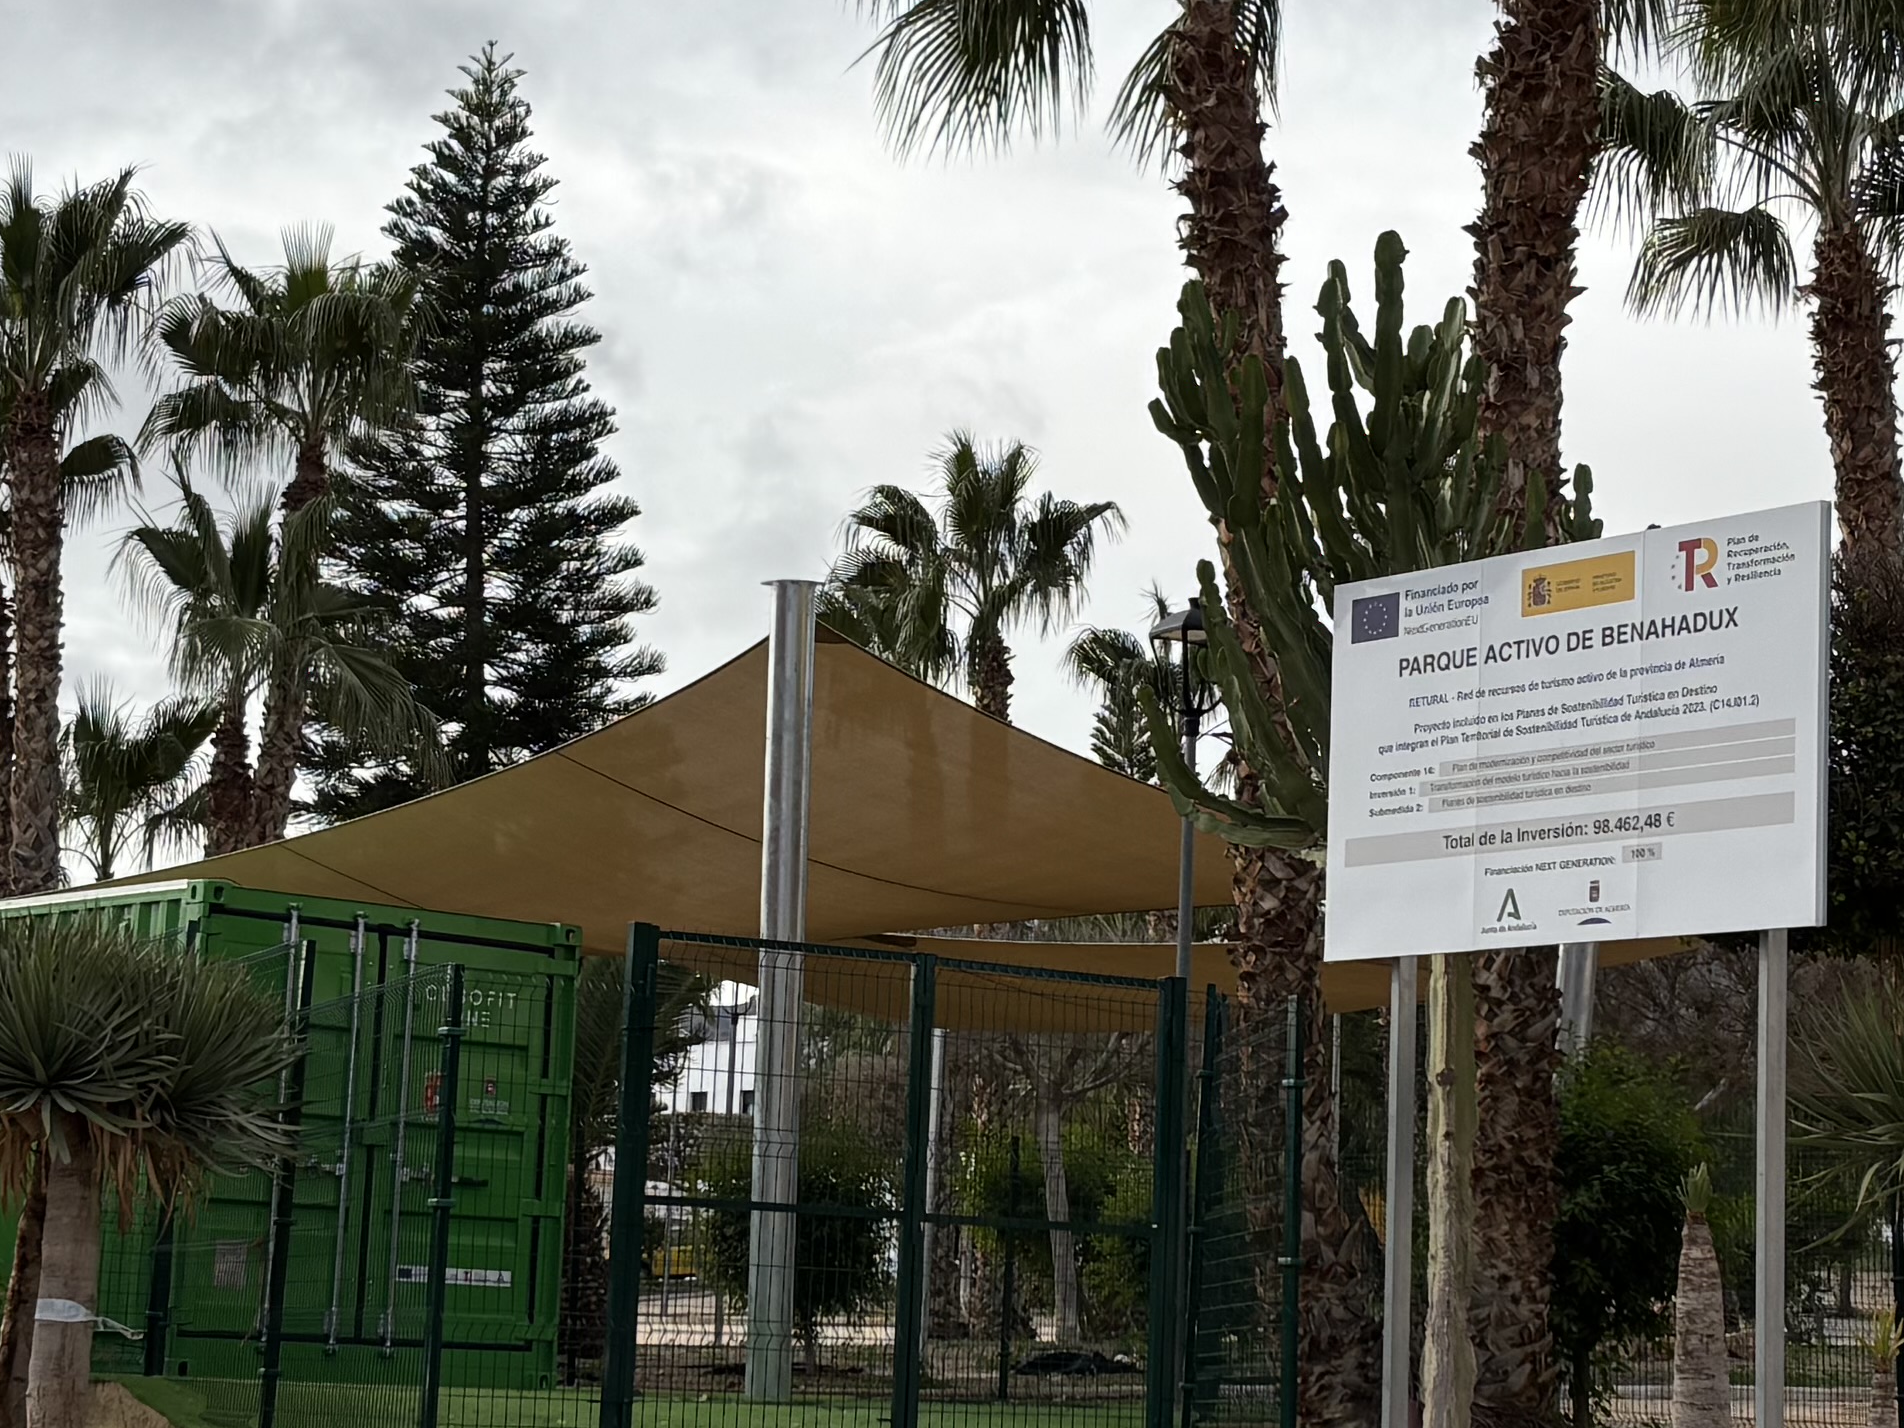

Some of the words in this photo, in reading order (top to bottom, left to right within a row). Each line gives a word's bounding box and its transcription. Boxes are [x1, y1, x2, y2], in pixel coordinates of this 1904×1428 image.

[1727, 535, 1745, 546] Plan
[1748, 532, 1759, 542] de
[1727, 552, 1794, 571] Transformación
[1735, 566, 1781, 582] Resiliencia
[1404, 581, 1458, 601] Financiado
[1461, 579, 1478, 593] por
[1404, 607, 1412, 617] la
[1415, 601, 1444, 615] Unión
[1447, 593, 1489, 612] Europea
[1399, 646, 1477, 677] PARQUE
[1484, 633, 1559, 665] ACTIVO
[1566, 628, 1593, 652] DE
[1601, 606, 1738, 647] BENAHADUX
[1457, 689, 1473, 701] Red
[1475, 687, 1485, 698] de
[1488, 683, 1525, 697] recursos
[1528, 679, 1538, 691] de
[1541, 675, 1574, 689] turismo
[1576, 671, 1603, 684] activo
[1606, 668, 1617, 680] de
[1619, 667, 1627, 678] la
[1629, 661, 1672, 679] provincia
[1674, 658, 1685, 670] de
[1689, 652, 1724, 668] Almería
[1414, 719, 1450, 735] Proyecto
[1452, 714, 1485, 728] incluido
[1487, 715, 1498, 723] en
[1501, 711, 1513, 721] los
[1547, 704, 1557, 715] de
[1561, 695, 1623, 714] Sostenibilidad
[1627, 689, 1664, 705] Turística
[1667, 690, 1678, 699] en
[1681, 683, 1717, 697] Destino
[1378, 744, 1392, 755] que
[1395, 737, 1428, 753] integran
[1430, 736, 1438, 746] el
[1440, 733, 1458, 745] Plan
[1461, 728, 1500, 743] Territorial
[1502, 726, 1513, 737] de
[1515, 717, 1577, 736] Sostenibilidad
[1581, 712, 1618, 727] Turística
[1620, 710, 1631, 722] de
[1452, 762, 1467, 772] Plan
[1469, 760, 1477, 770] de
[1479, 754, 1530, 769] modernización
[1537, 747, 1587, 764] competitividad
[1590, 746, 1600, 756] del
[1370, 768, 1420, 783] Componente
[1482, 776, 1492, 786] del
[1494, 772, 1520, 784] modelo
[1580, 760, 1629, 775] sostenibilidad
[1369, 787, 1406, 799] Inversión
[1368, 804, 1413, 817] Submedida
[1442, 831, 1474, 849] Total
[1478, 829, 1495, 845] de
[1500, 828, 1512, 843] la
[1517, 820, 1587, 842] Inversión:
[1593, 812, 1661, 837] 98.462,48
[1484, 863, 1533, 876] Financiación
[1536, 861, 1555, 871] NEXT
